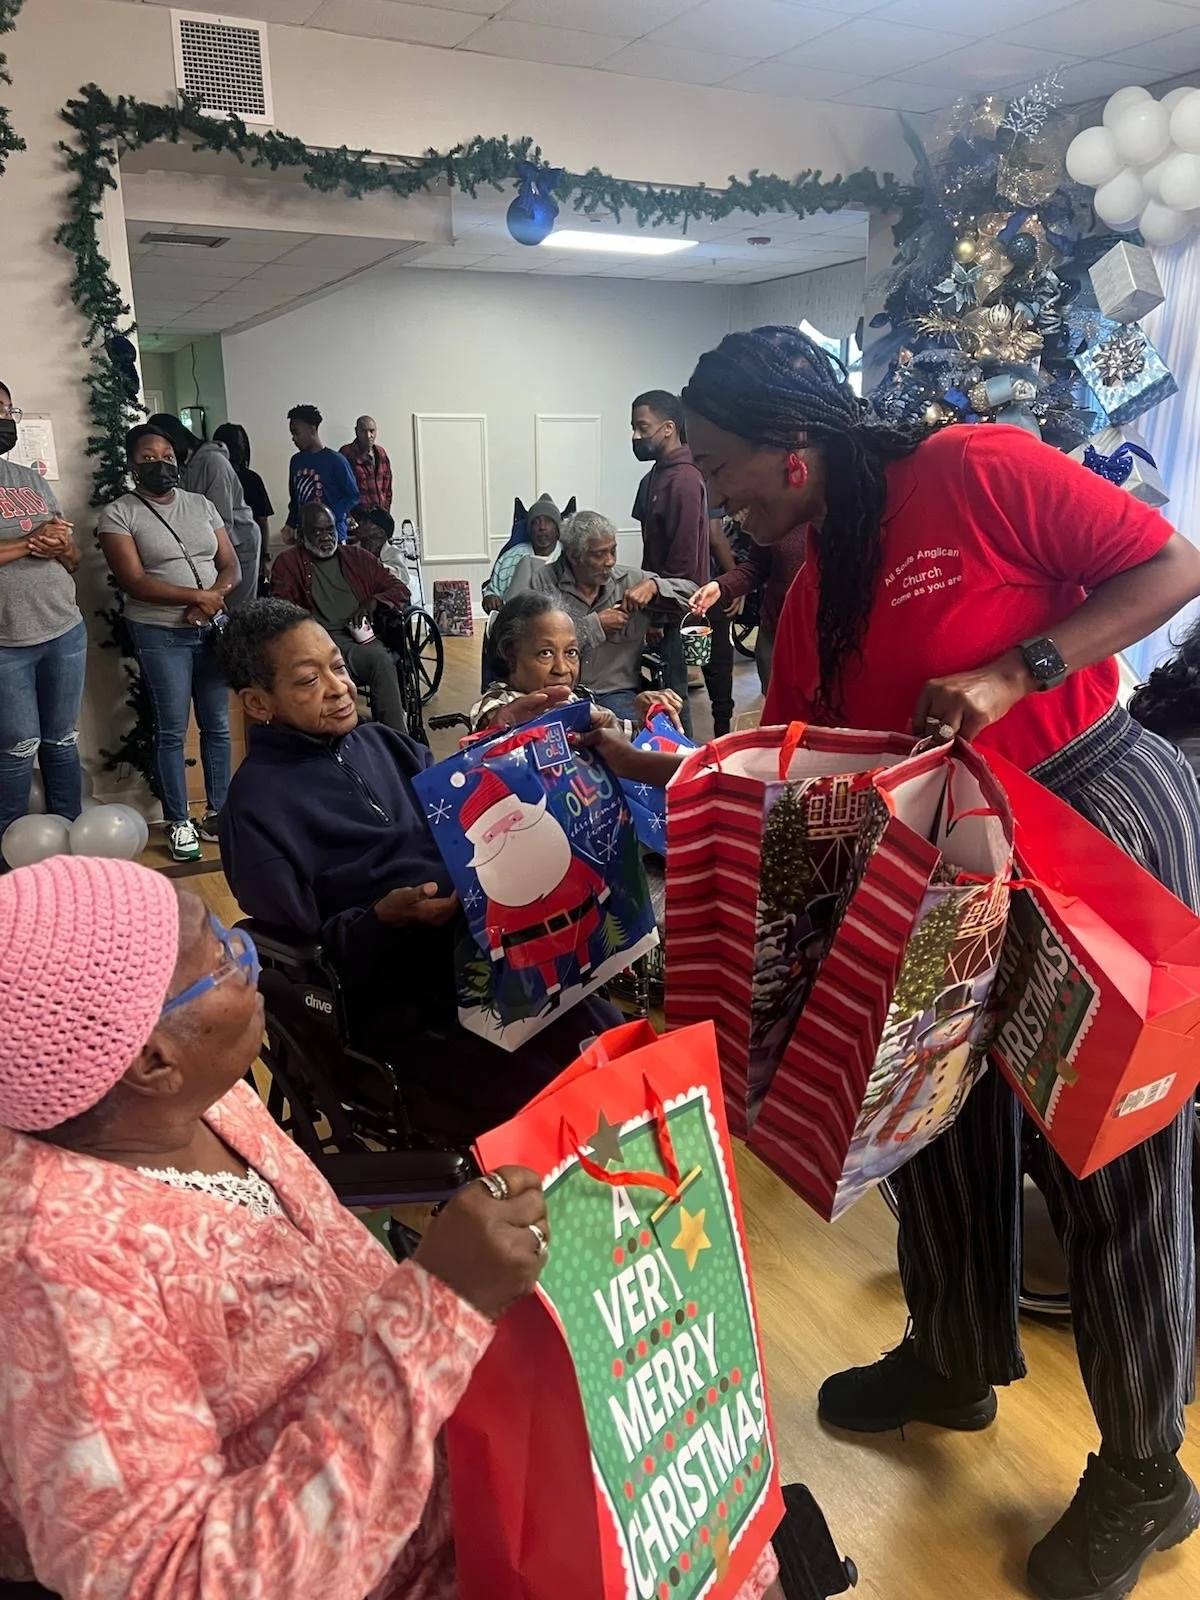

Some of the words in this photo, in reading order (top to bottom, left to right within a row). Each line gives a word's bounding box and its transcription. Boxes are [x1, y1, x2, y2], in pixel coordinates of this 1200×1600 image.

[0, 486, 48, 518] HIO
[884, 573, 896, 587] All
[895, 556, 914, 575] Souls
[917, 547, 960, 560] Anglican
[902, 566, 943, 588] Church
[890, 592, 912, 607] Come
[914, 586, 926, 596] as
[927, 581, 946, 593] you
[948, 575, 962, 586] are
[305, 994, 333, 1014] drive
[994, 928, 1069, 1081] HRISTMAS
[612, 1185, 641, 1240] A
[608, 1312, 720, 1464] MERRY
[628, 1370, 765, 1600] CHRISTMAS
